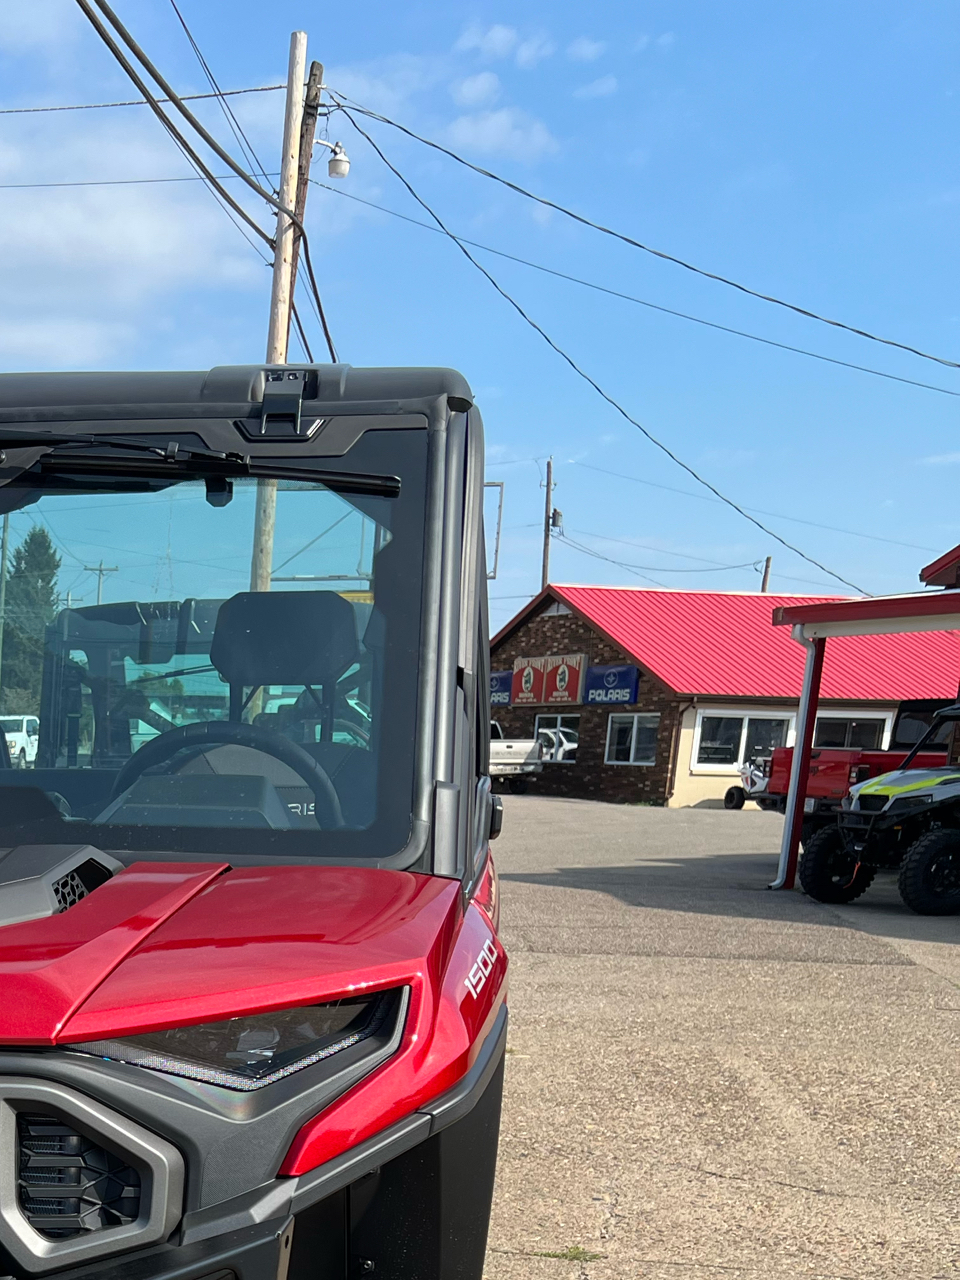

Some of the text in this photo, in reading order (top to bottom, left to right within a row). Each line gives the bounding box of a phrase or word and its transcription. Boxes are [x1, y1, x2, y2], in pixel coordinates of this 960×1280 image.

[490, 692, 509, 703] ARIS
[589, 689, 630, 701] POLARIS
[463, 938, 498, 1000] 1500
